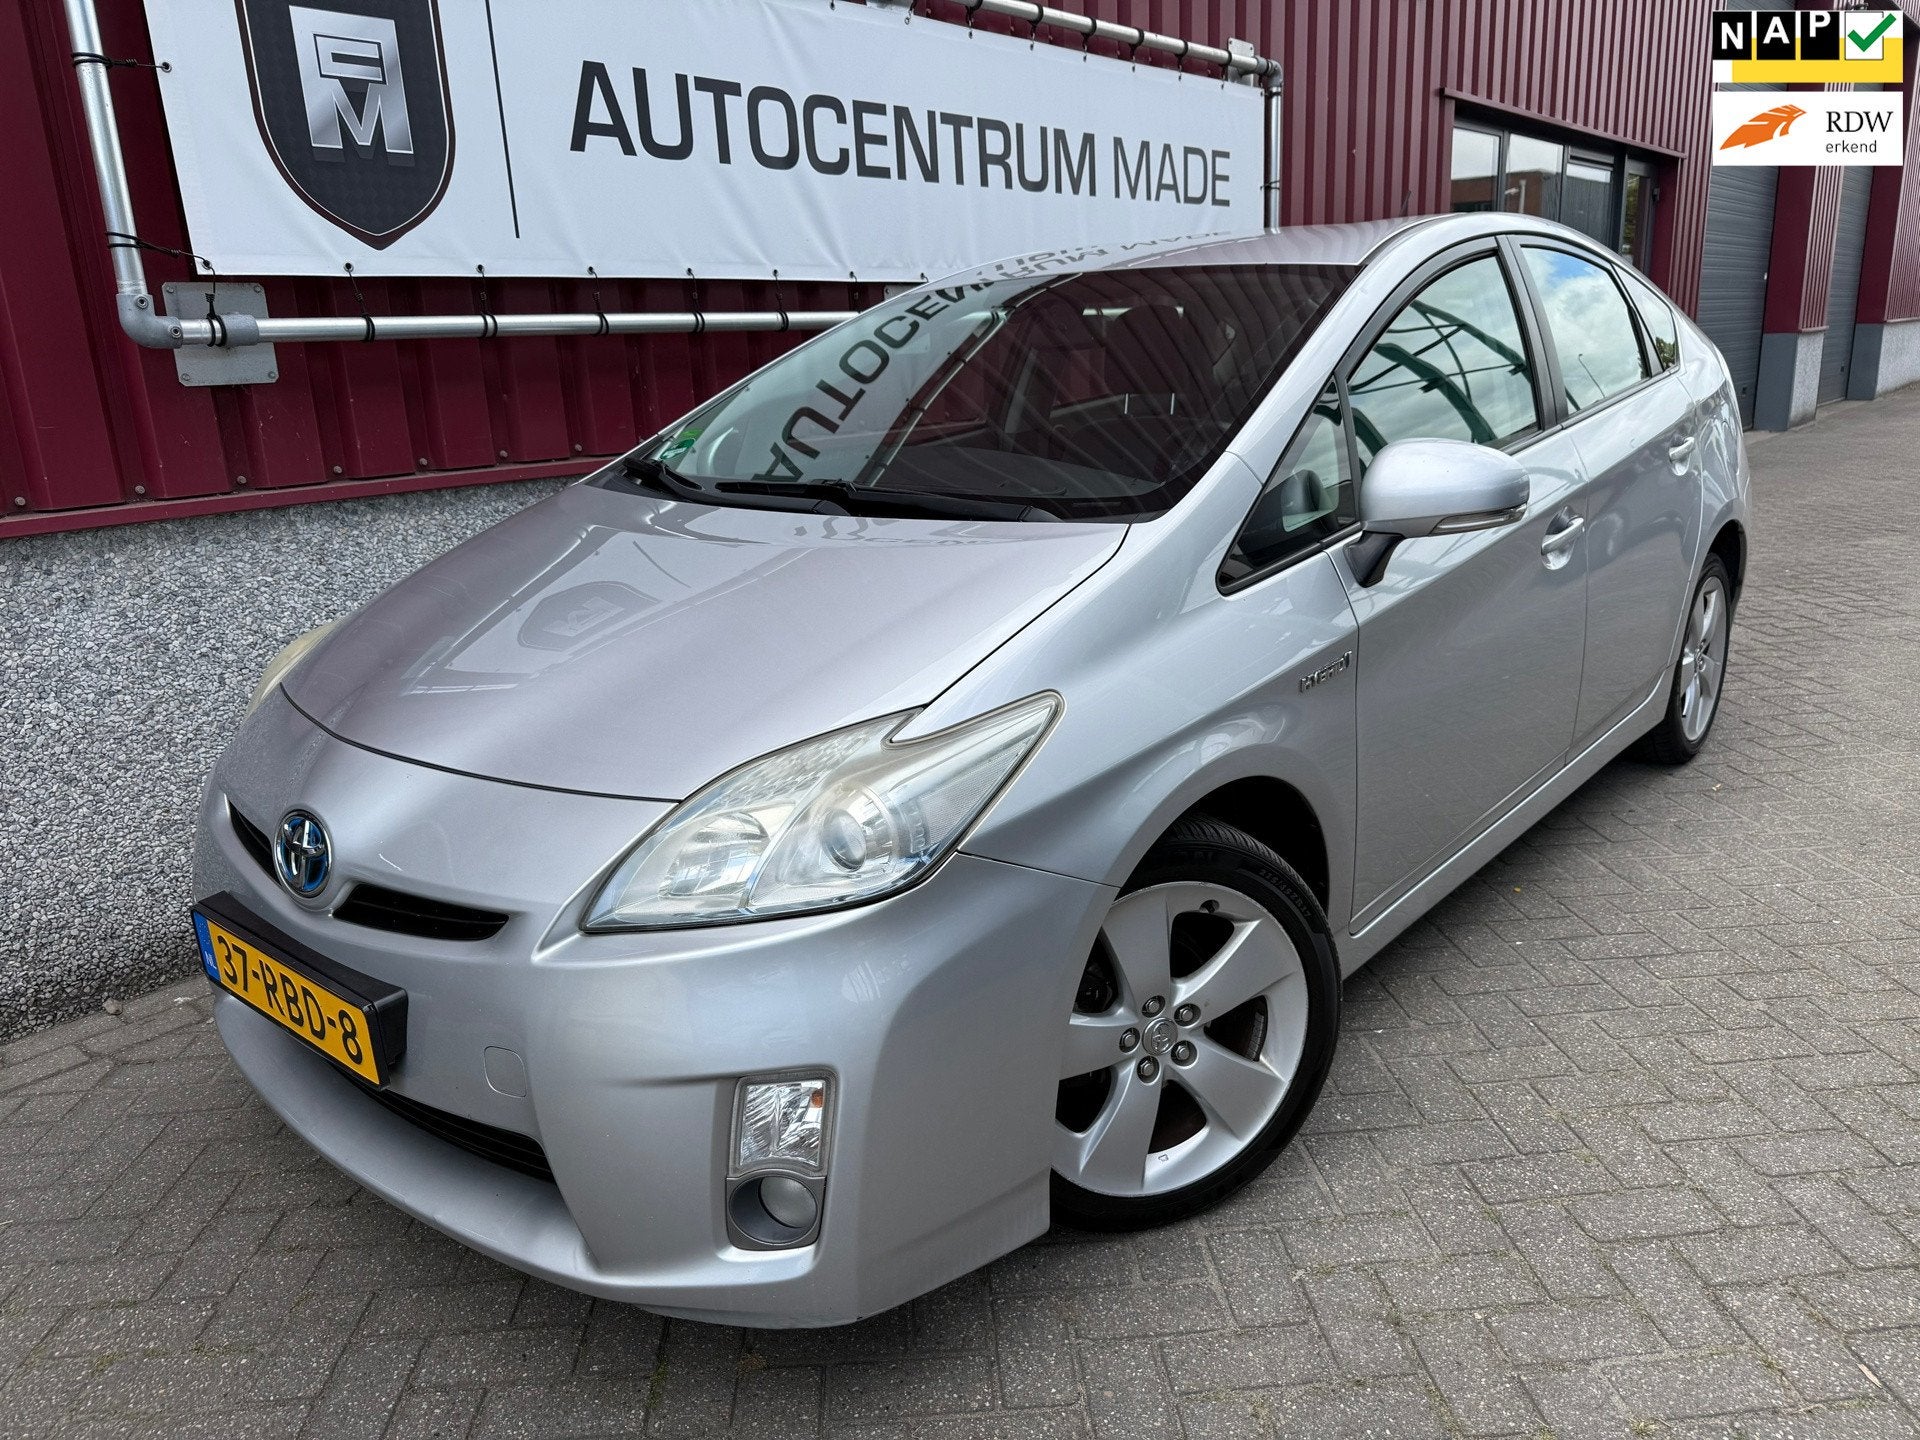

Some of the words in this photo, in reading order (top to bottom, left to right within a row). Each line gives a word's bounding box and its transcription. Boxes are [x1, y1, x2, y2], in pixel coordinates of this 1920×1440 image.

[570, 60, 1096, 197] AUTOCENTRUM
[1113, 136, 1231, 207] MADE
[217, 934, 363, 1065] 37-RBD-8
